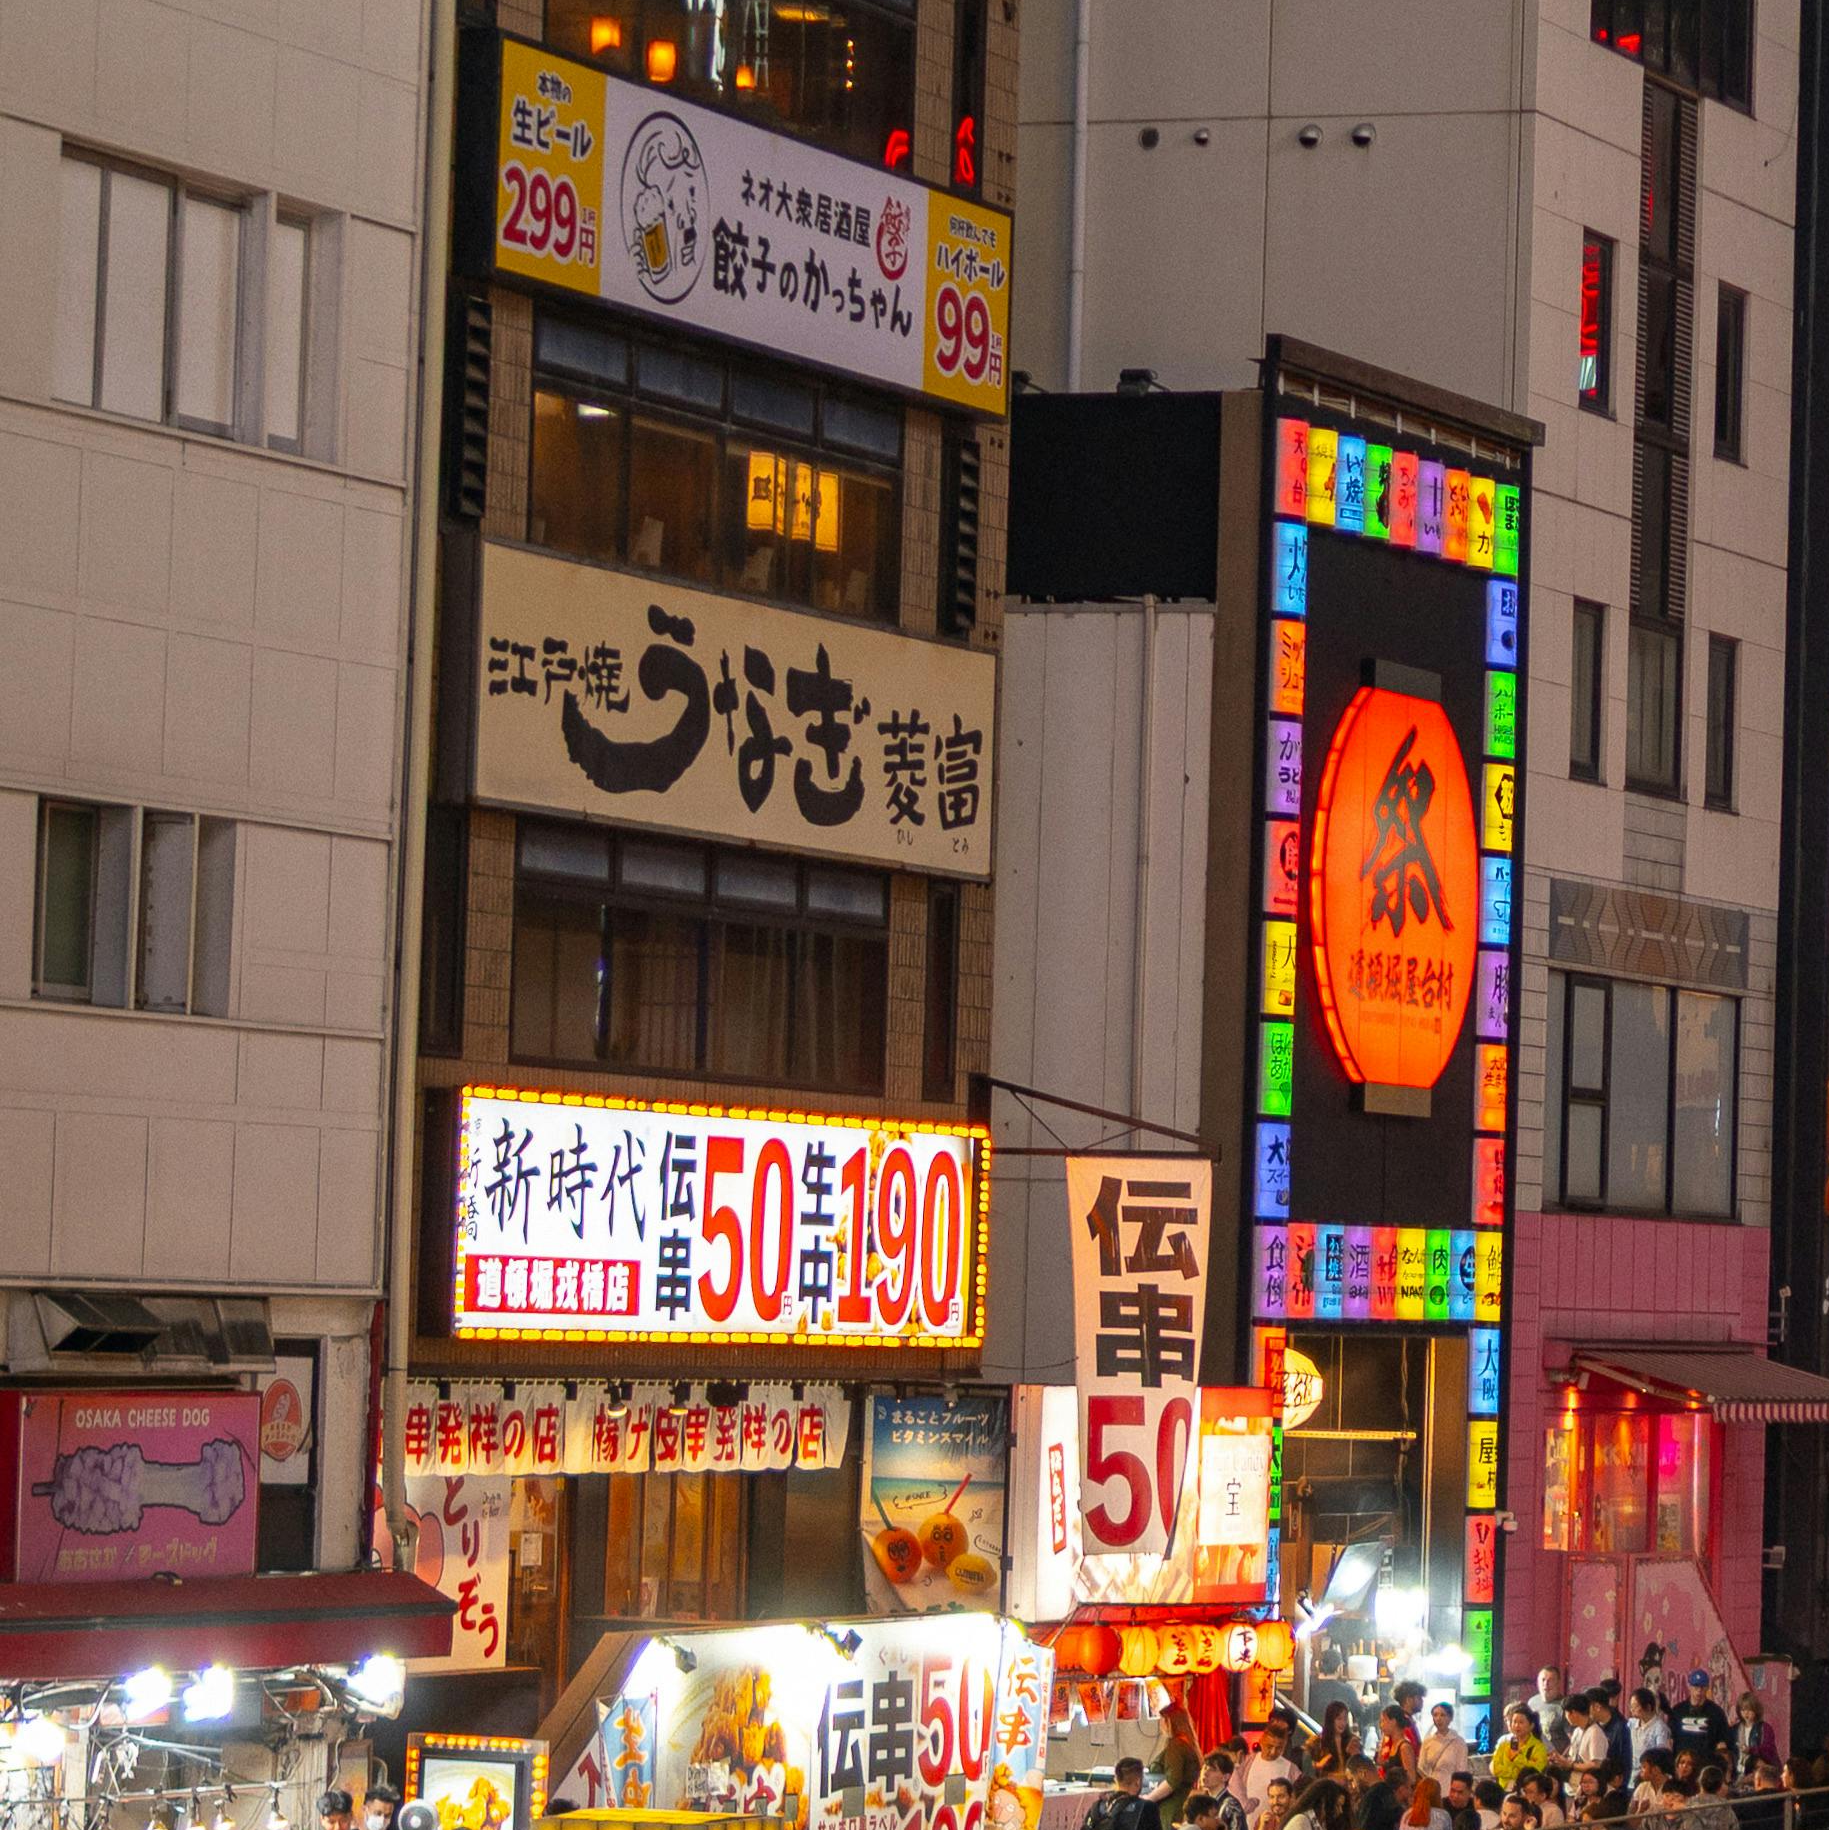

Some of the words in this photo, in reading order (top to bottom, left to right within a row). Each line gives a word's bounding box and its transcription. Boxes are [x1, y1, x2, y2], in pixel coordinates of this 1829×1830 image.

[512, 97, 593, 159] 生ビール
[502, 166, 577, 258] 299
[741, 169, 871, 248] ネオ大衆居酒屋
[712, 216, 913, 338] 餃子のかっちゃん
[938, 245, 1005, 289] ハイボール
[937, 287, 990, 380] 99
[562, 604, 869, 827] うなぎ
[878, 709, 982, 832] 菱富
[484, 1117, 646, 1245] 新時代
[655, 1131, 697, 1321] 伝串
[698, 1136, 794, 1321] 50
[800, 1141, 836, 1324] 生中
[838, 1147, 960, 1326] 190
[477, 1258, 629, 1313] 道頓堀戎橋店
[1086, 1176, 1199, 1387] 伝串
[75, 1408, 121, 1429] OSAKA
[128, 1407, 177, 1428] CHEESE
[182, 1407, 210, 1427] DOG
[377, 1402, 560, 1466] 串発祥の店
[595, 1401, 825, 1462] 揚げ皮串発祥の店
[891, 1430, 989, 1445] ビタミンスマイル
[892, 1410, 989, 1425] まるごとフルーツ
[1085, 1396, 1192, 1547] 50
[444, 1476, 499, 1658] とりぞう
[817, 1671, 913, 1798] 伝串
[918, 1650, 993, 1788] 50
[996, 1653, 1038, 1755] 伝串
